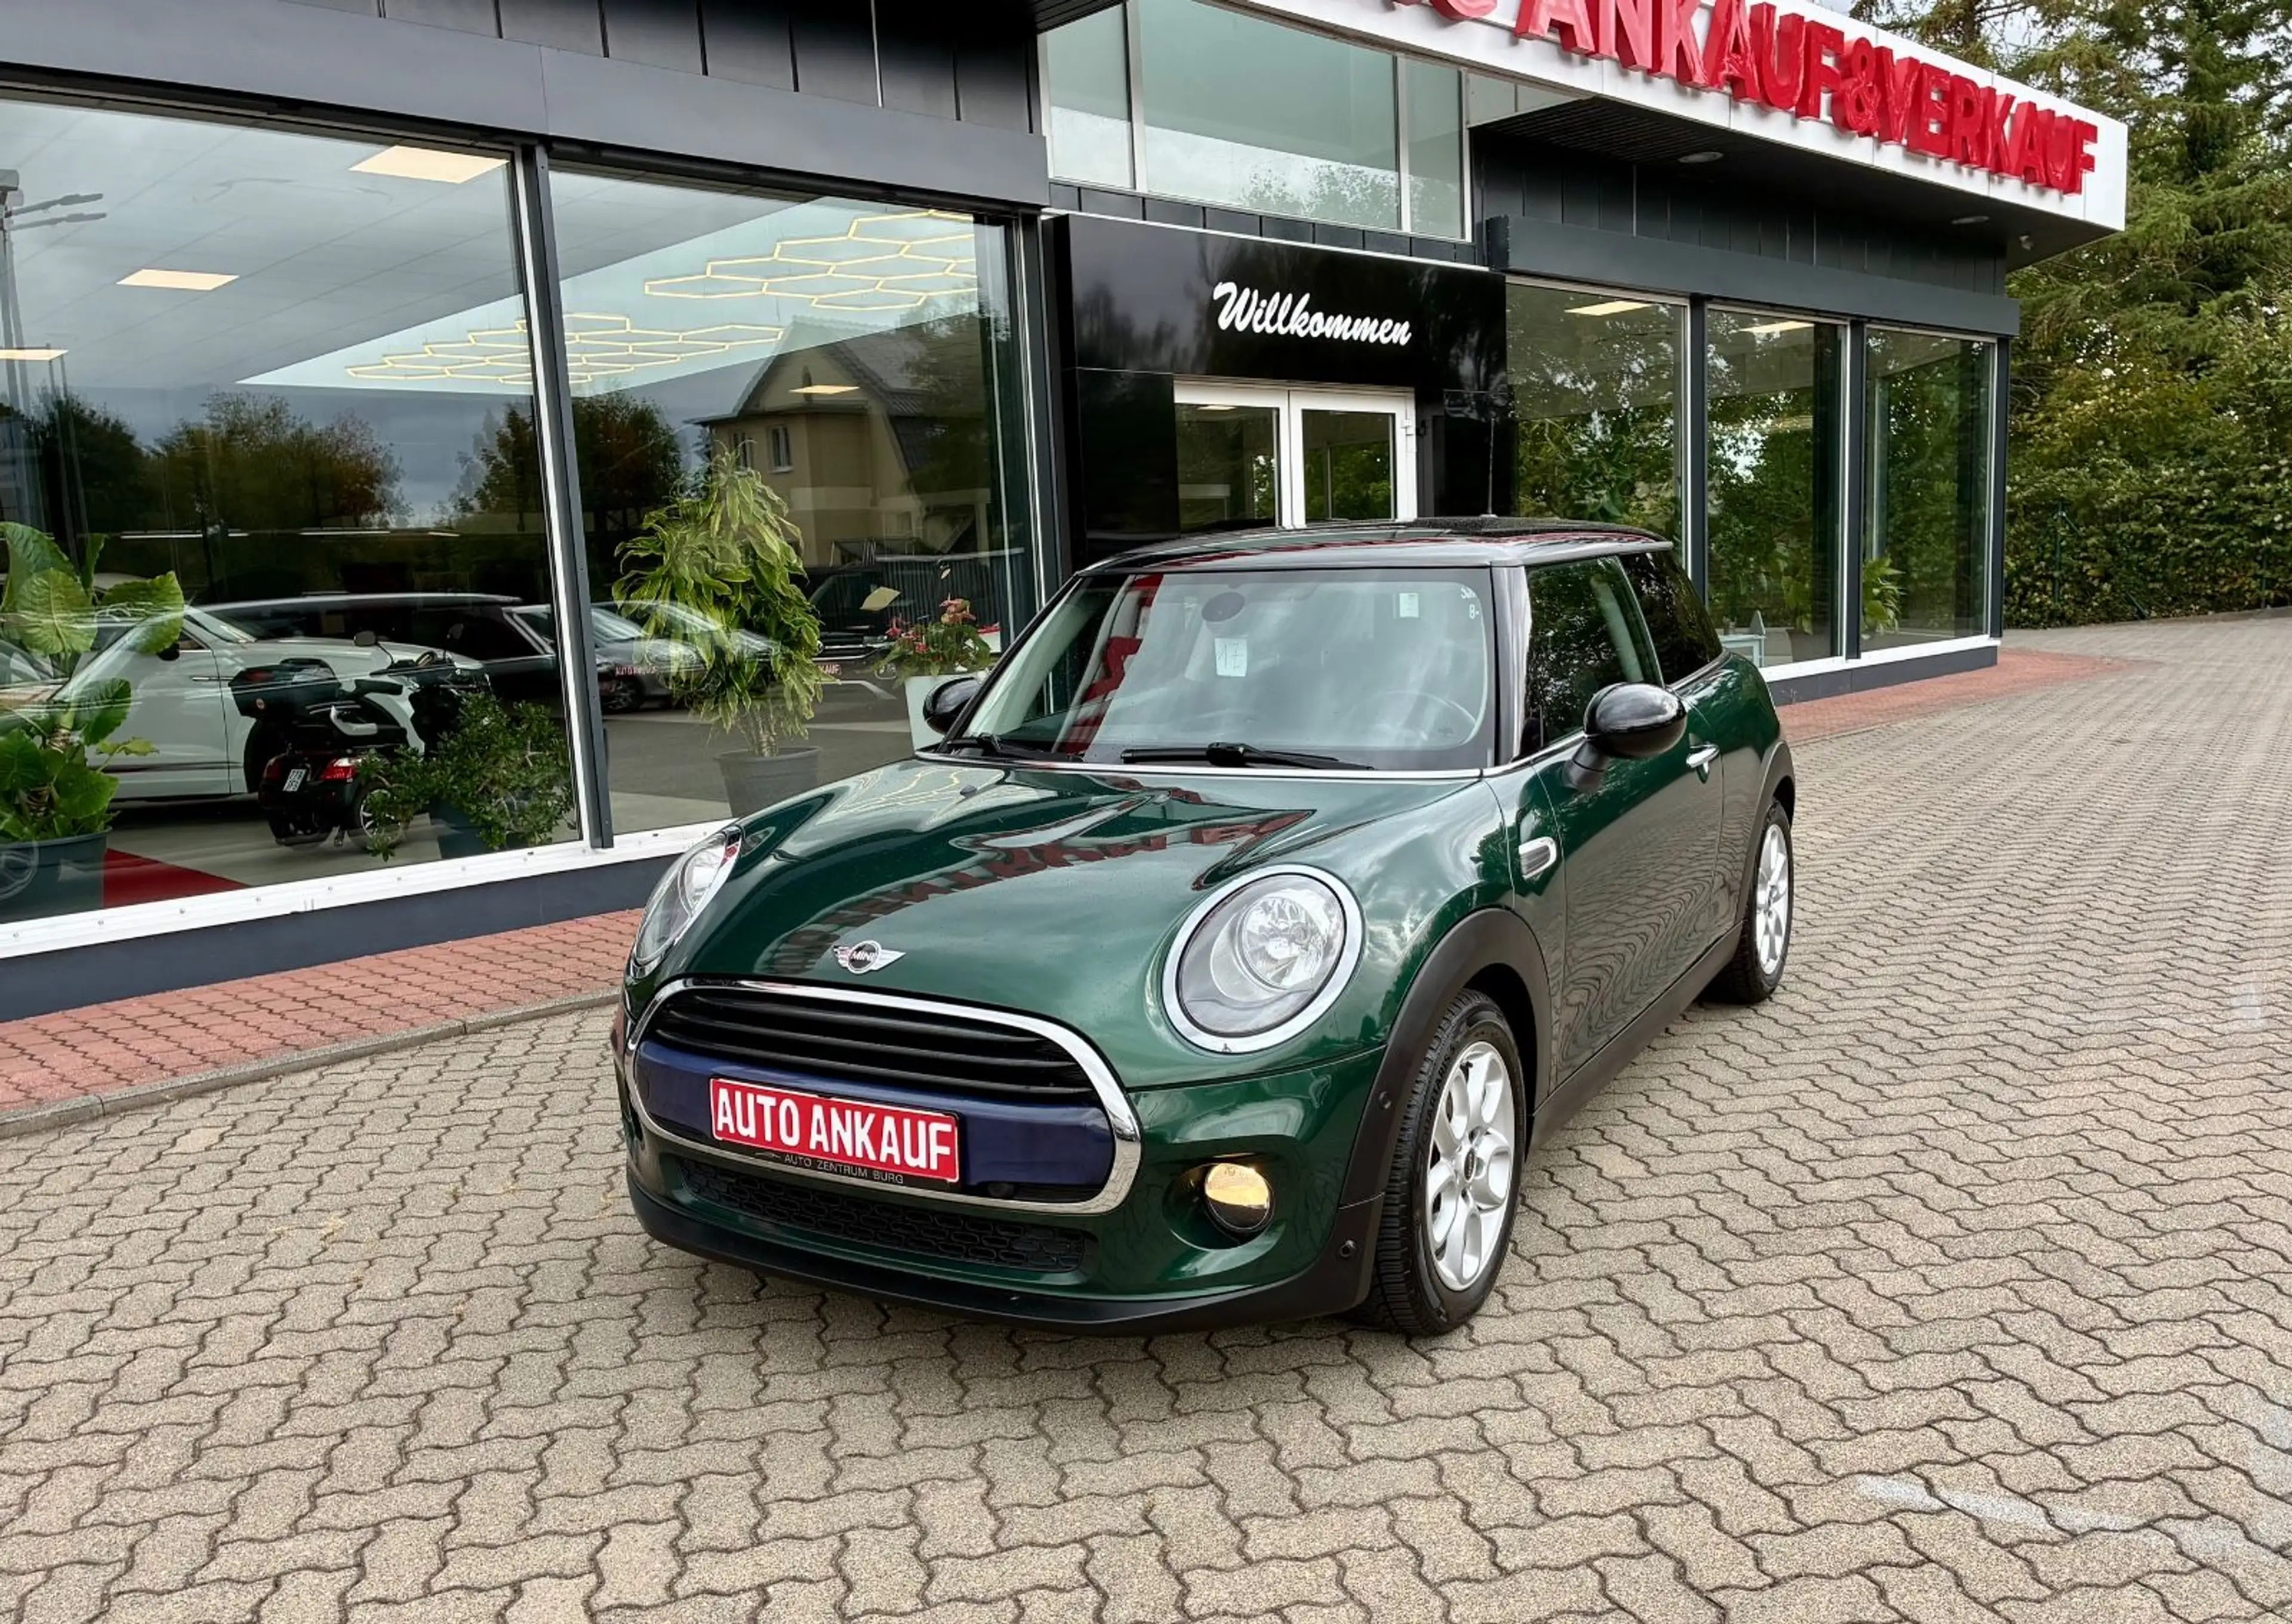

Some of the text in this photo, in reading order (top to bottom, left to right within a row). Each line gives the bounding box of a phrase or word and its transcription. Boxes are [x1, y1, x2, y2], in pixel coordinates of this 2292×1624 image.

[1213, 282, 1412, 346] Willkommen
[851, 950, 875, 962] MINI
[717, 1087, 953, 1170] AUTO ANKAUF
[785, 1154, 904, 1184] AUTO ZENTRUM BURG
